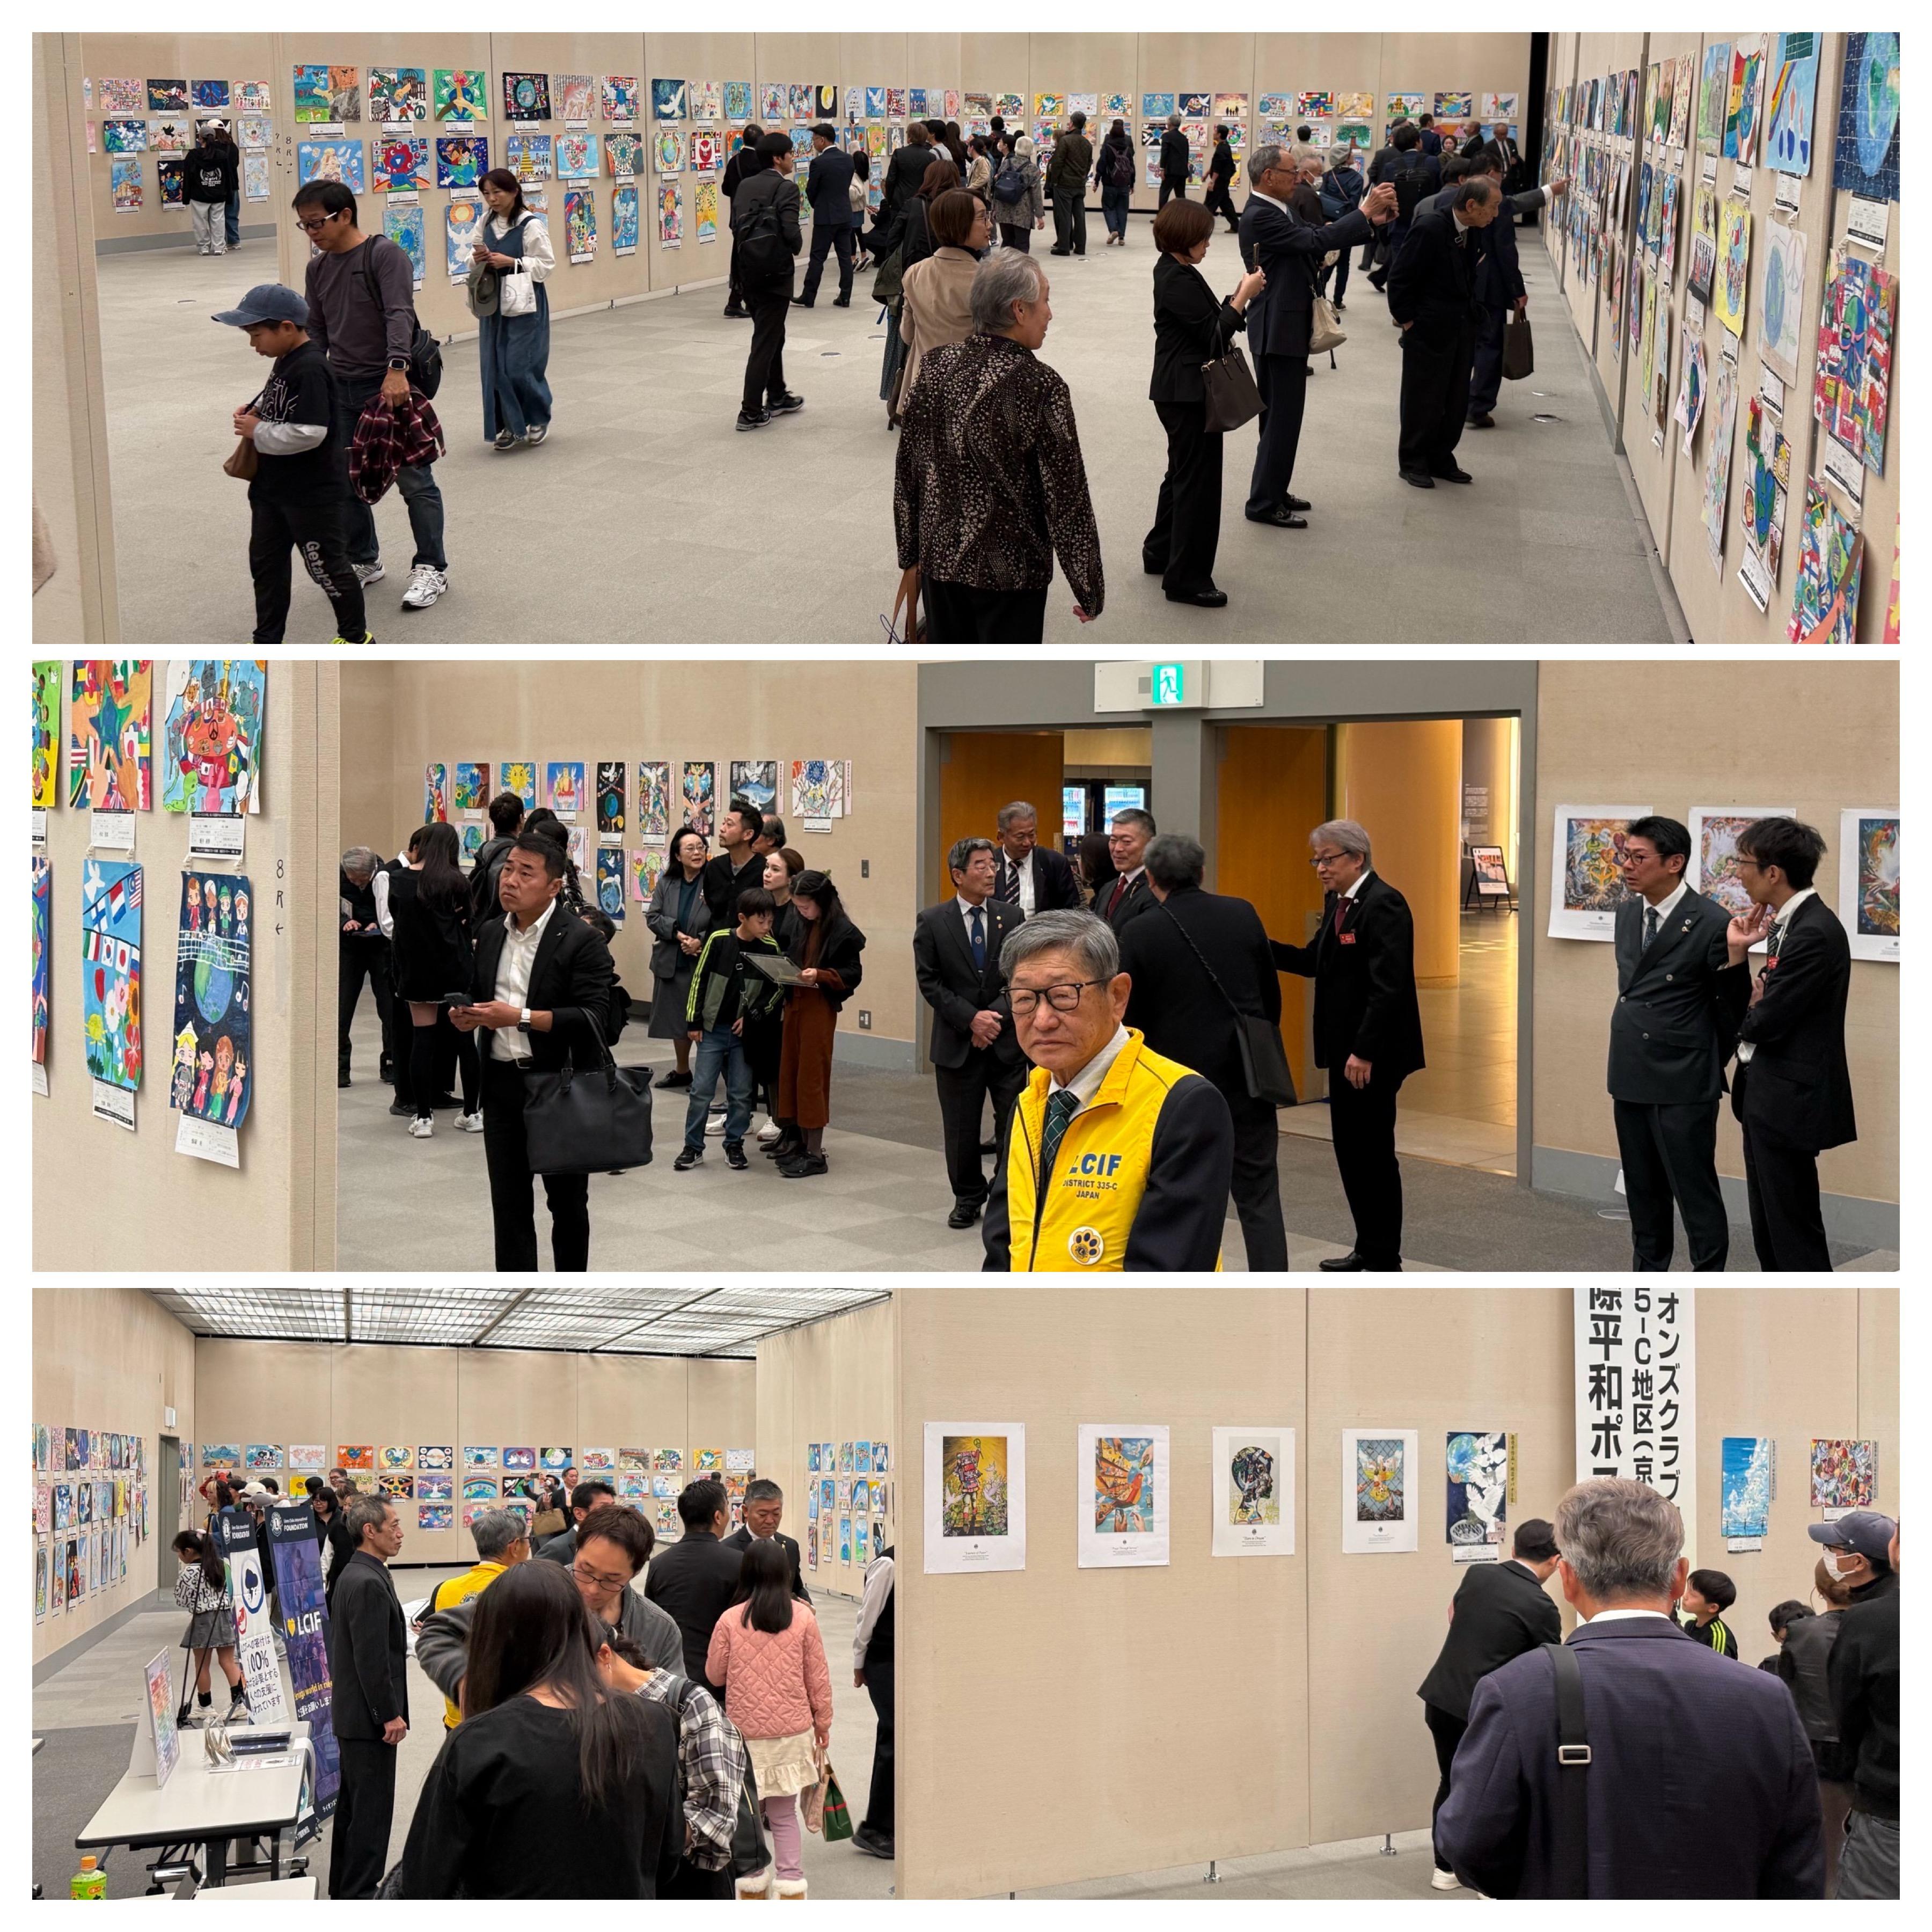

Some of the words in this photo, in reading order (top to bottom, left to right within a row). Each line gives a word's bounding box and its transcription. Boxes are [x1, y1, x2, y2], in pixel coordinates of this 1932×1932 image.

[1076, 1190, 1100, 1199] JAPAN
[1096, 1181, 1118, 1191] 335-C
[297, 1611, 321, 1636] LCIF
[246, 1649, 269, 1674] 100%
